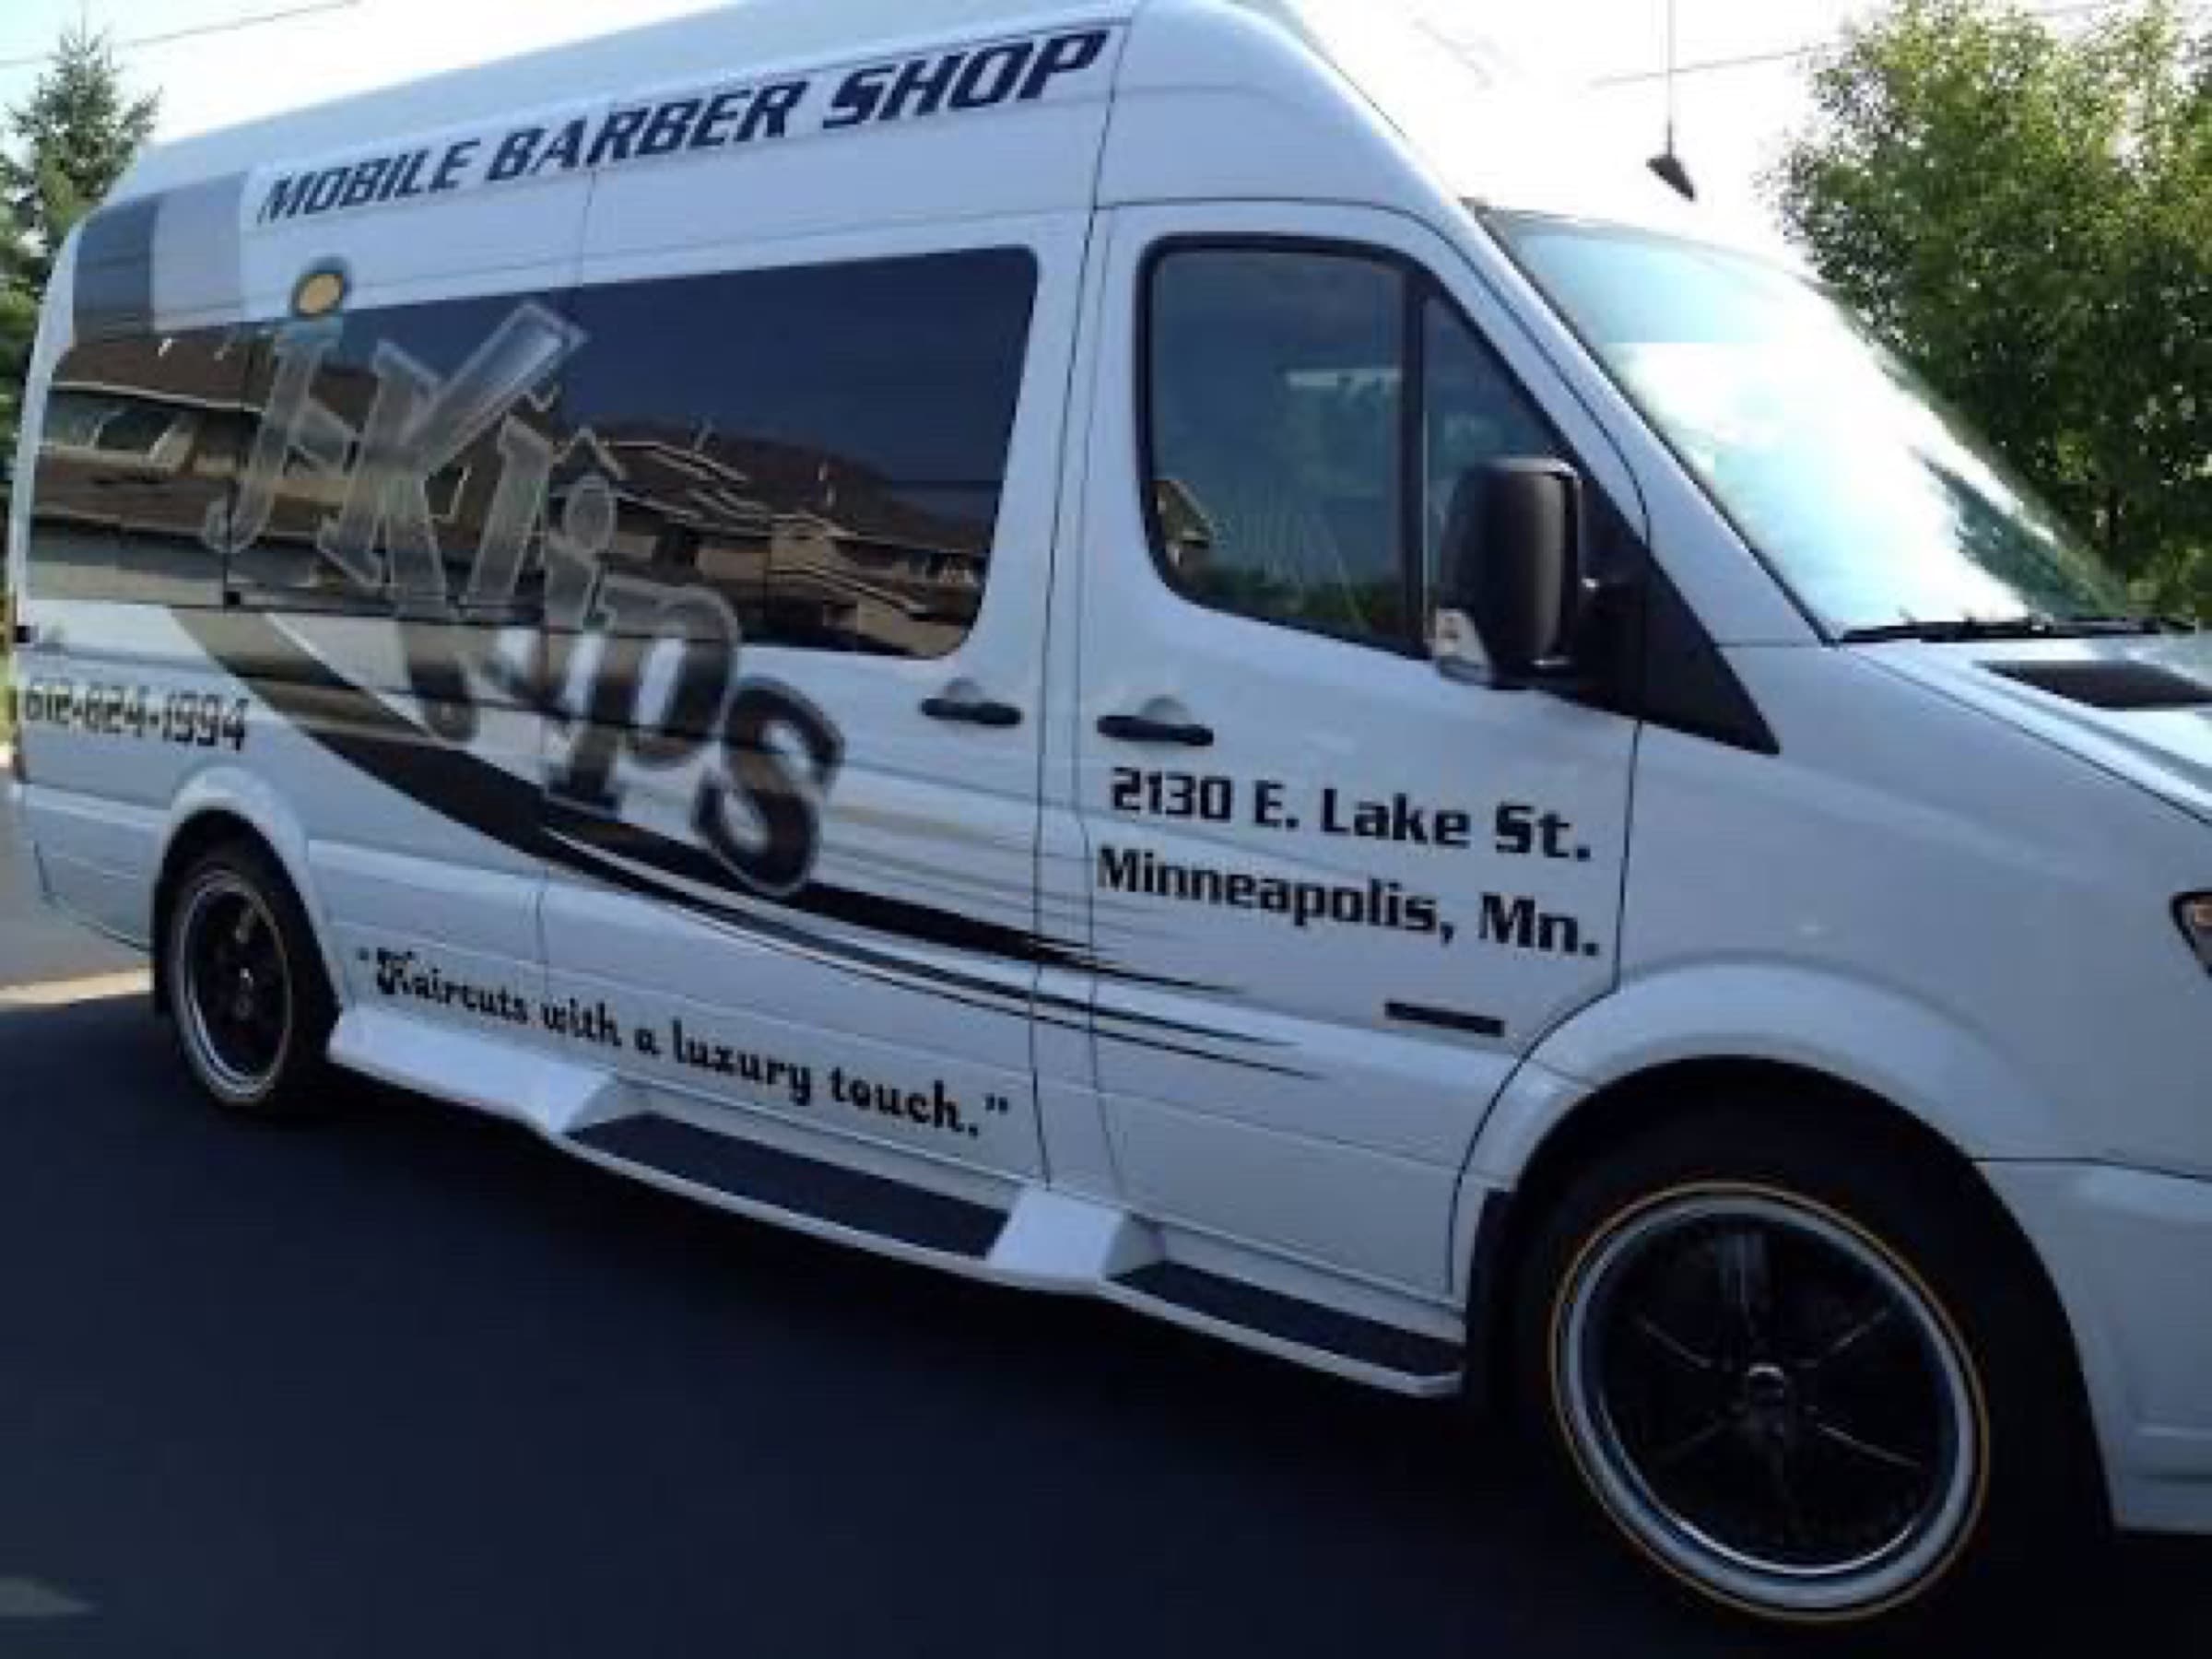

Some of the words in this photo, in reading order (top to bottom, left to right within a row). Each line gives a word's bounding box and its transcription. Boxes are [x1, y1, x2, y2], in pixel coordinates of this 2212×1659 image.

[257, 138, 480, 223] MOBILE
[487, 81, 808, 181] BARBER
[822, 29, 1109, 130] SHOP
[1112, 767, 1233, 821] 2130
[1254, 779, 1300, 829] E.
[1321, 788, 1472, 848] Lake
[1496, 802, 1592, 862] St.
[1098, 845, 1454, 946] Minneapolis,
[1478, 892, 1599, 957] Mn.
[542, 998, 622, 1047] with
[634, 1028, 661, 1057] a
[672, 1019, 813, 1105] luxury
[829, 1067, 1009, 1136] touch."
